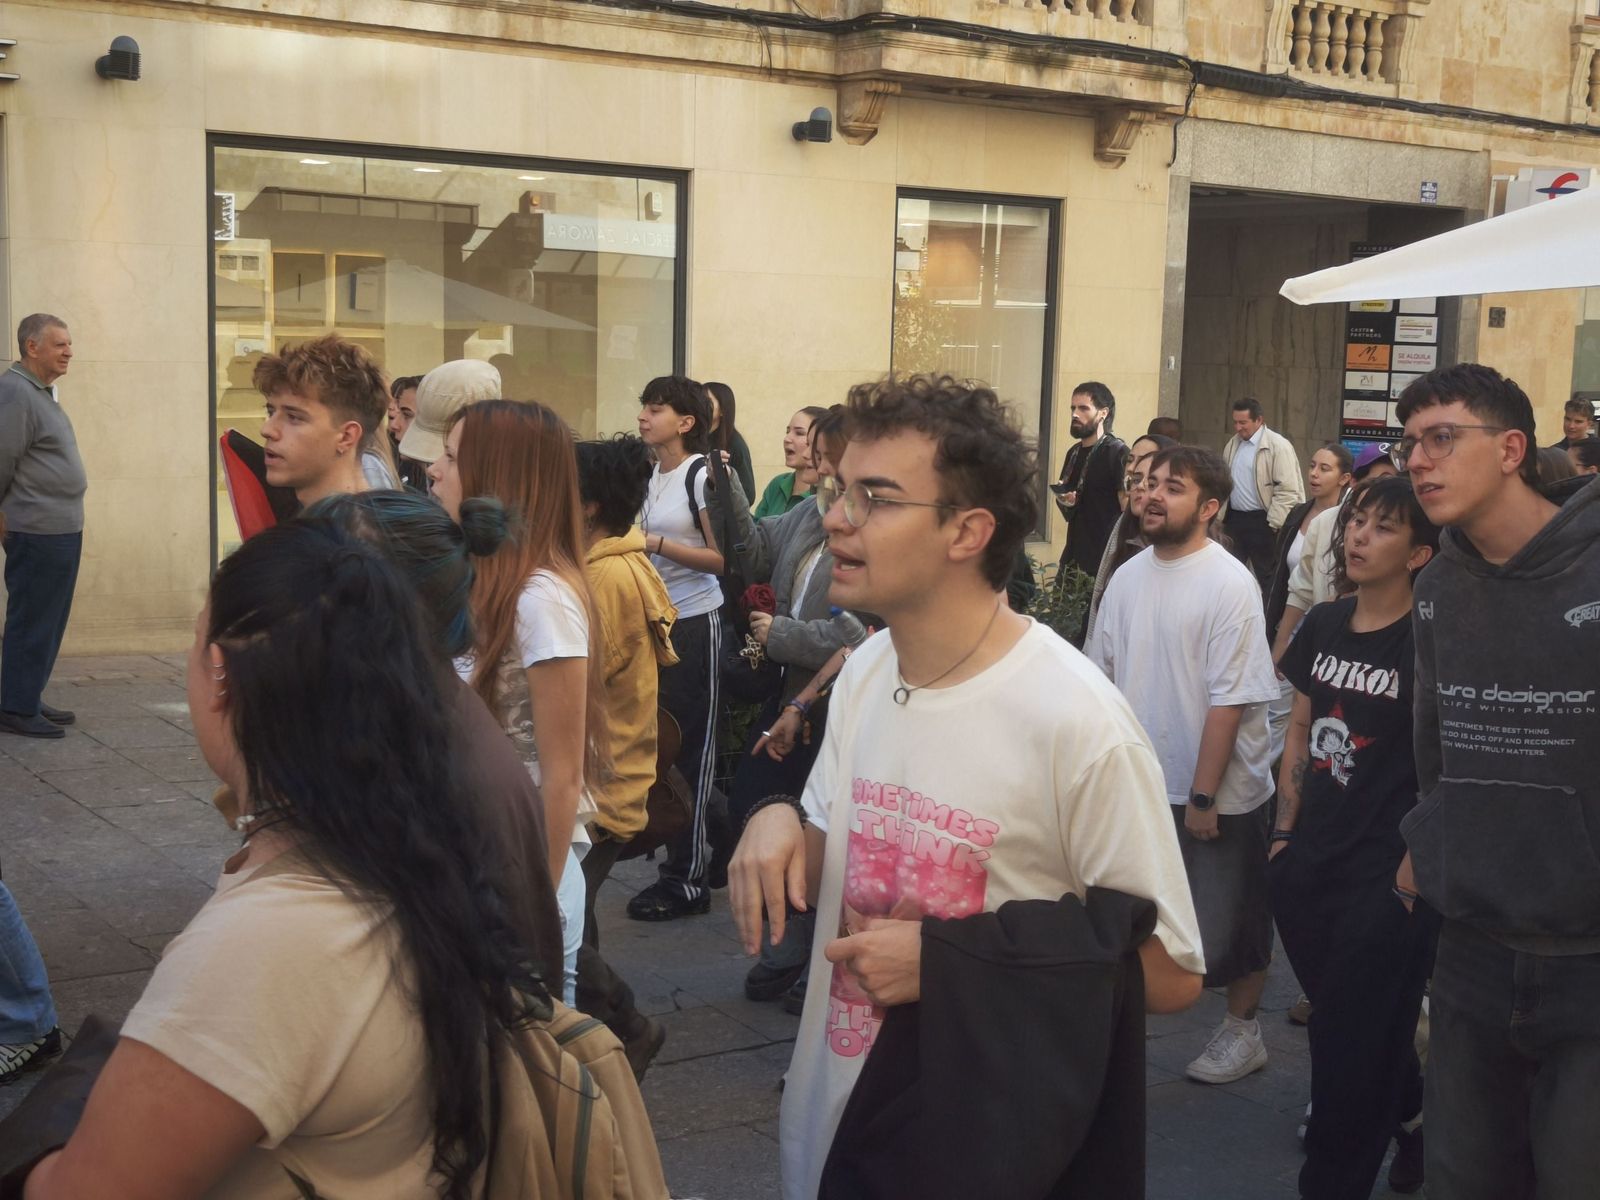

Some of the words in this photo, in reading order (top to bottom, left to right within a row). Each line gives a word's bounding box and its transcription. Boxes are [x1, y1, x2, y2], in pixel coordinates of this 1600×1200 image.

[1406, 353, 1431, 361] ALQUILA
[1443, 699, 1472, 710] LIFE
[1480, 704, 1515, 713] WITH
[1523, 706, 1596, 715] PASSION
[1485, 724, 1501, 733] THE
[1501, 726, 1521, 735] BEST
[1523, 727, 1550, 736] THING
[1447, 730, 1459, 738] DO
[1460, 732, 1469, 740] IS
[1470, 733, 1487, 742] LOG
[1487, 735, 1504, 743] OFF
[1504, 737, 1522, 745] AND
[1523, 738, 1576, 746] RECONNECT
[1454, 741, 1480, 751] WHAT
[1480, 745, 1505, 754] TRULY
